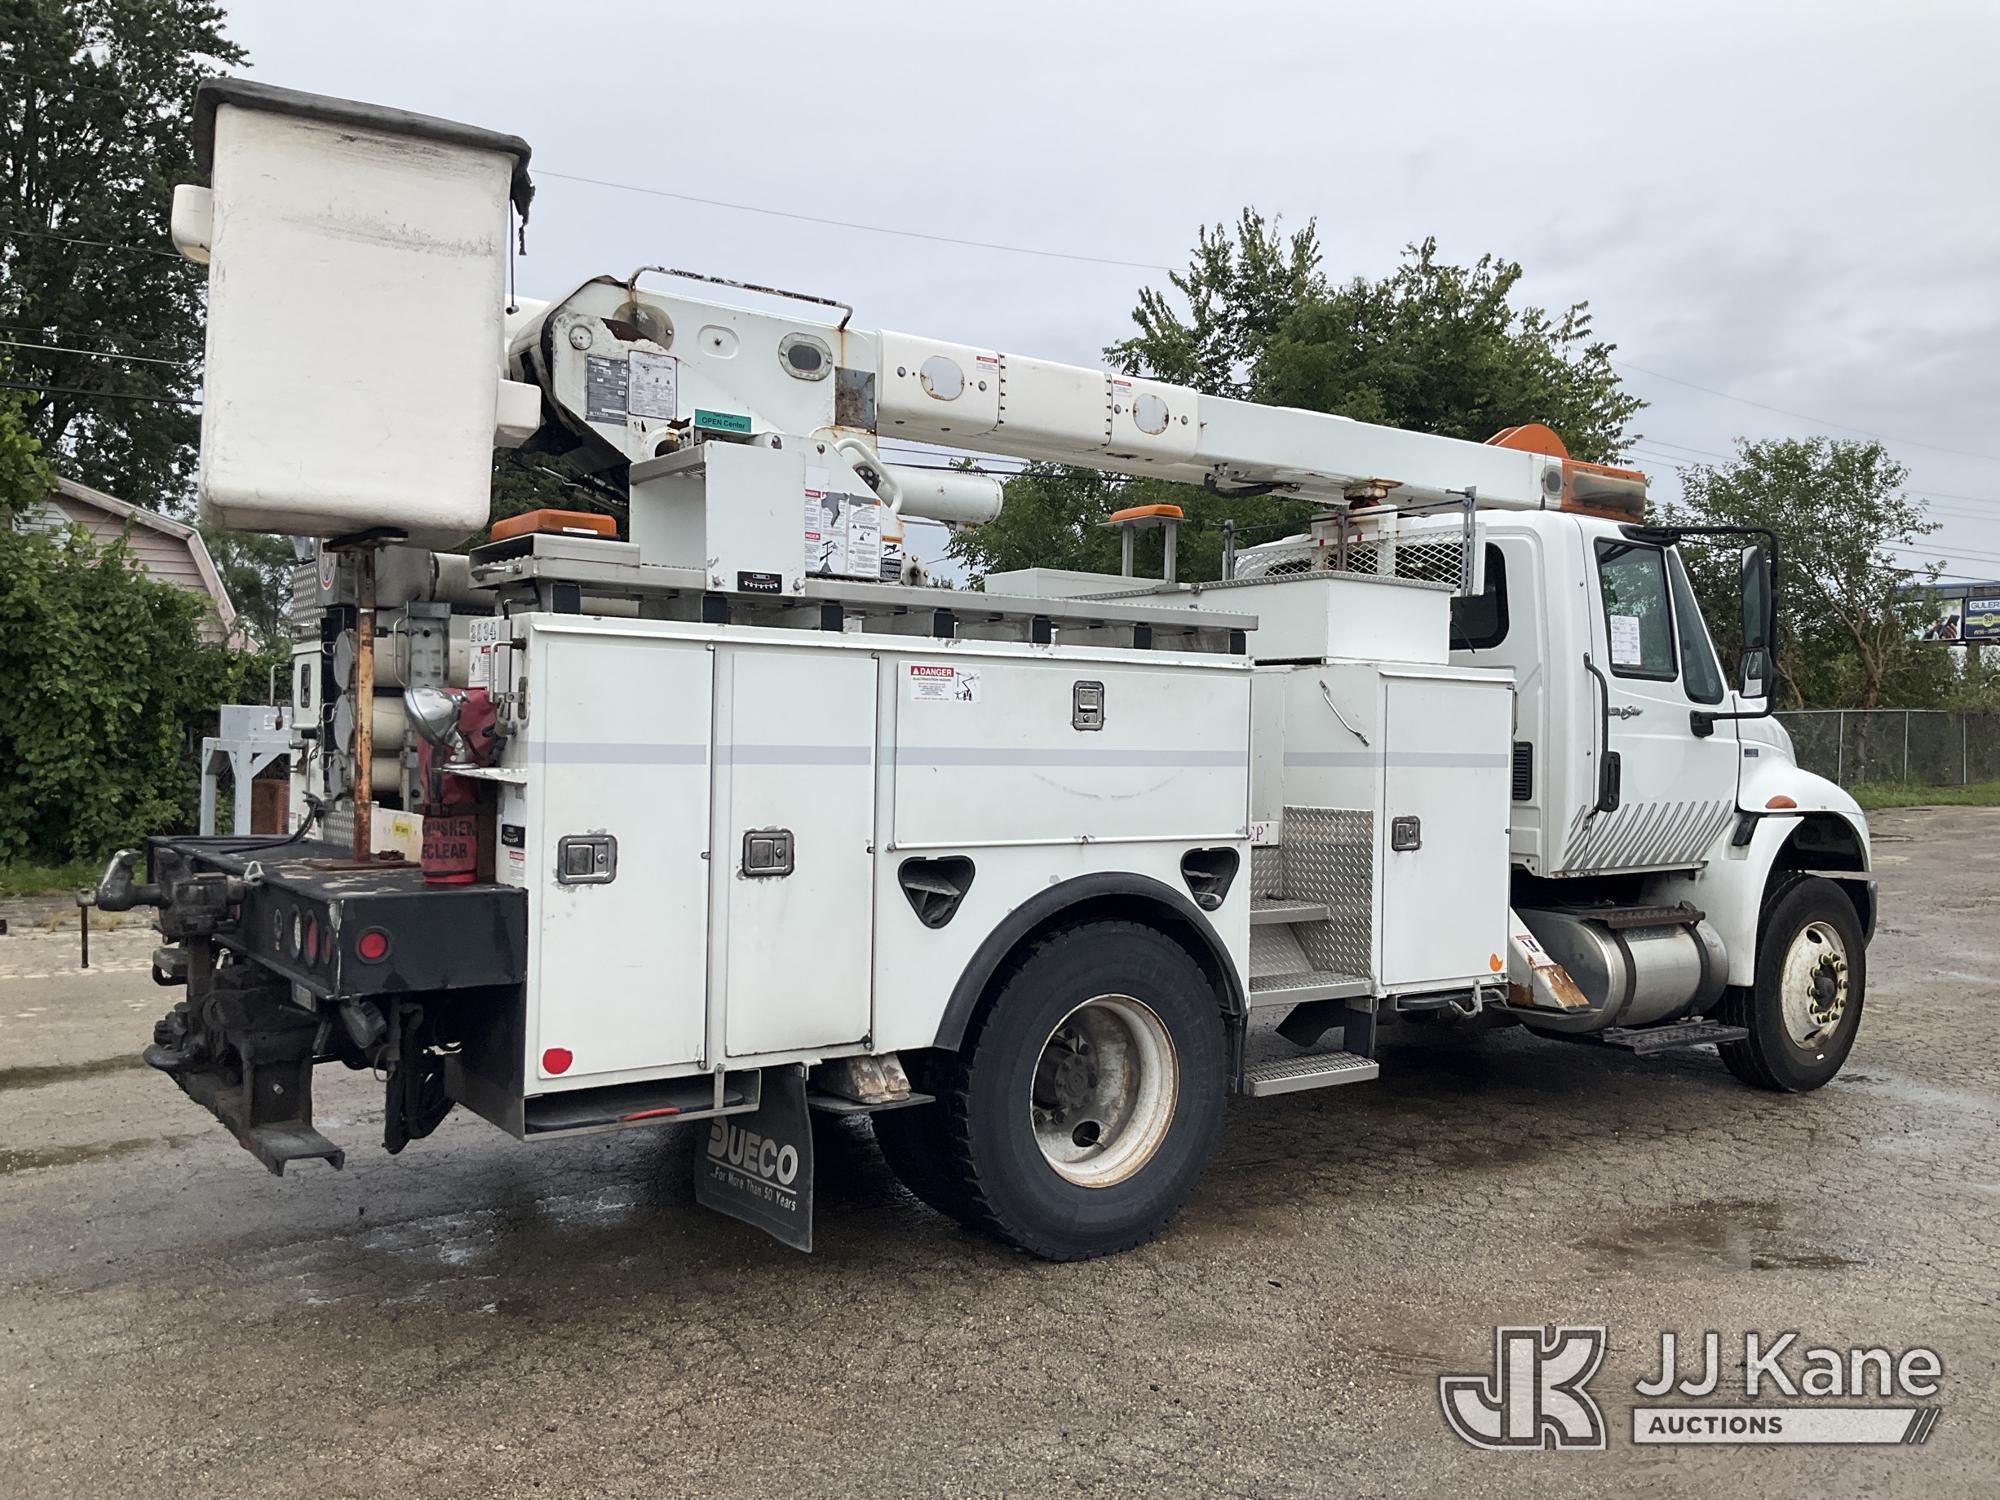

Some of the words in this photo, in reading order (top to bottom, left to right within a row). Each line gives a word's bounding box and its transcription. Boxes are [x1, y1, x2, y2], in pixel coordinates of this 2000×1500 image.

[701, 416, 722, 426] OPEN
[723, 419, 745, 429] Center
[920, 667, 952, 677] DANGER
[707, 1115, 799, 1186] DUECO
[728, 1171, 744, 1189] More
[747, 1179, 762, 1196] Than
[764, 1186, 773, 1201] 50
[776, 1191, 797, 1211] Years
